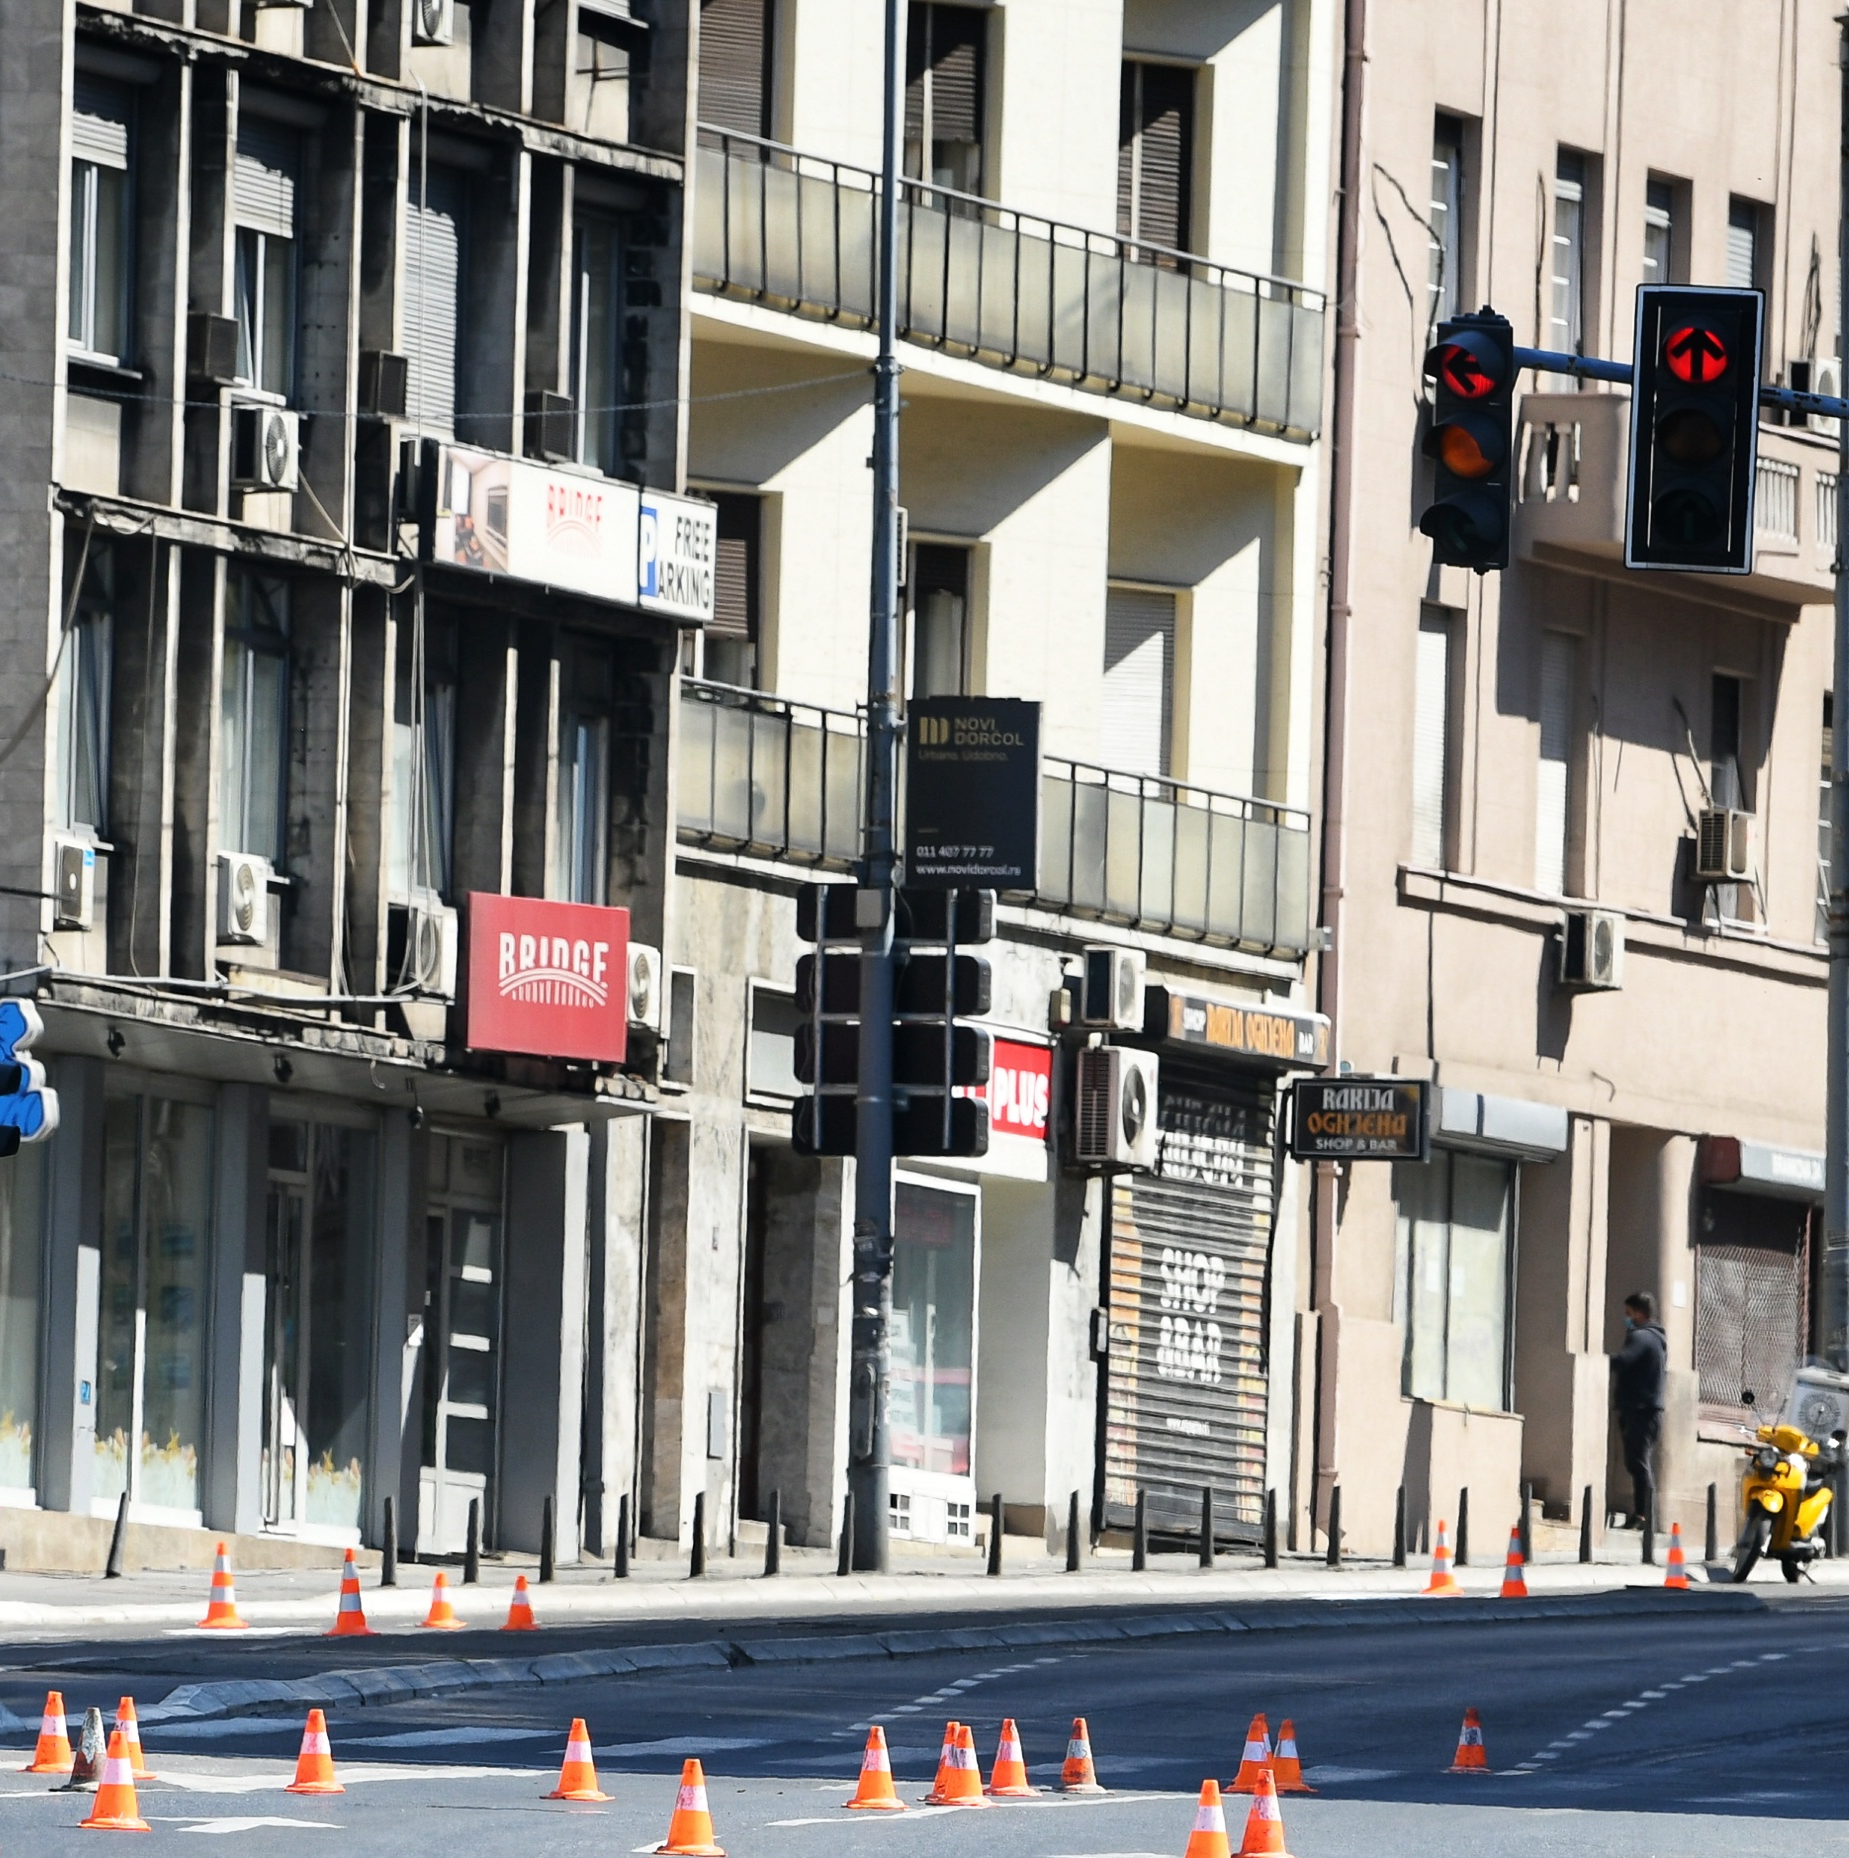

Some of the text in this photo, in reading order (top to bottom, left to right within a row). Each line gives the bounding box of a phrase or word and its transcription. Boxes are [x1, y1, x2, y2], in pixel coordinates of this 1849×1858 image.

[676, 515, 711, 563] FREE
[954, 717, 996, 731] NOVI
[499, 932, 610, 985] BRIDGE
[993, 1066, 1049, 1128] PLUS
[1322, 1087, 1395, 1112] RAKIJA
[1315, 1139, 1354, 1151] SHOP
[1369, 1139, 1398, 1151] BAR
